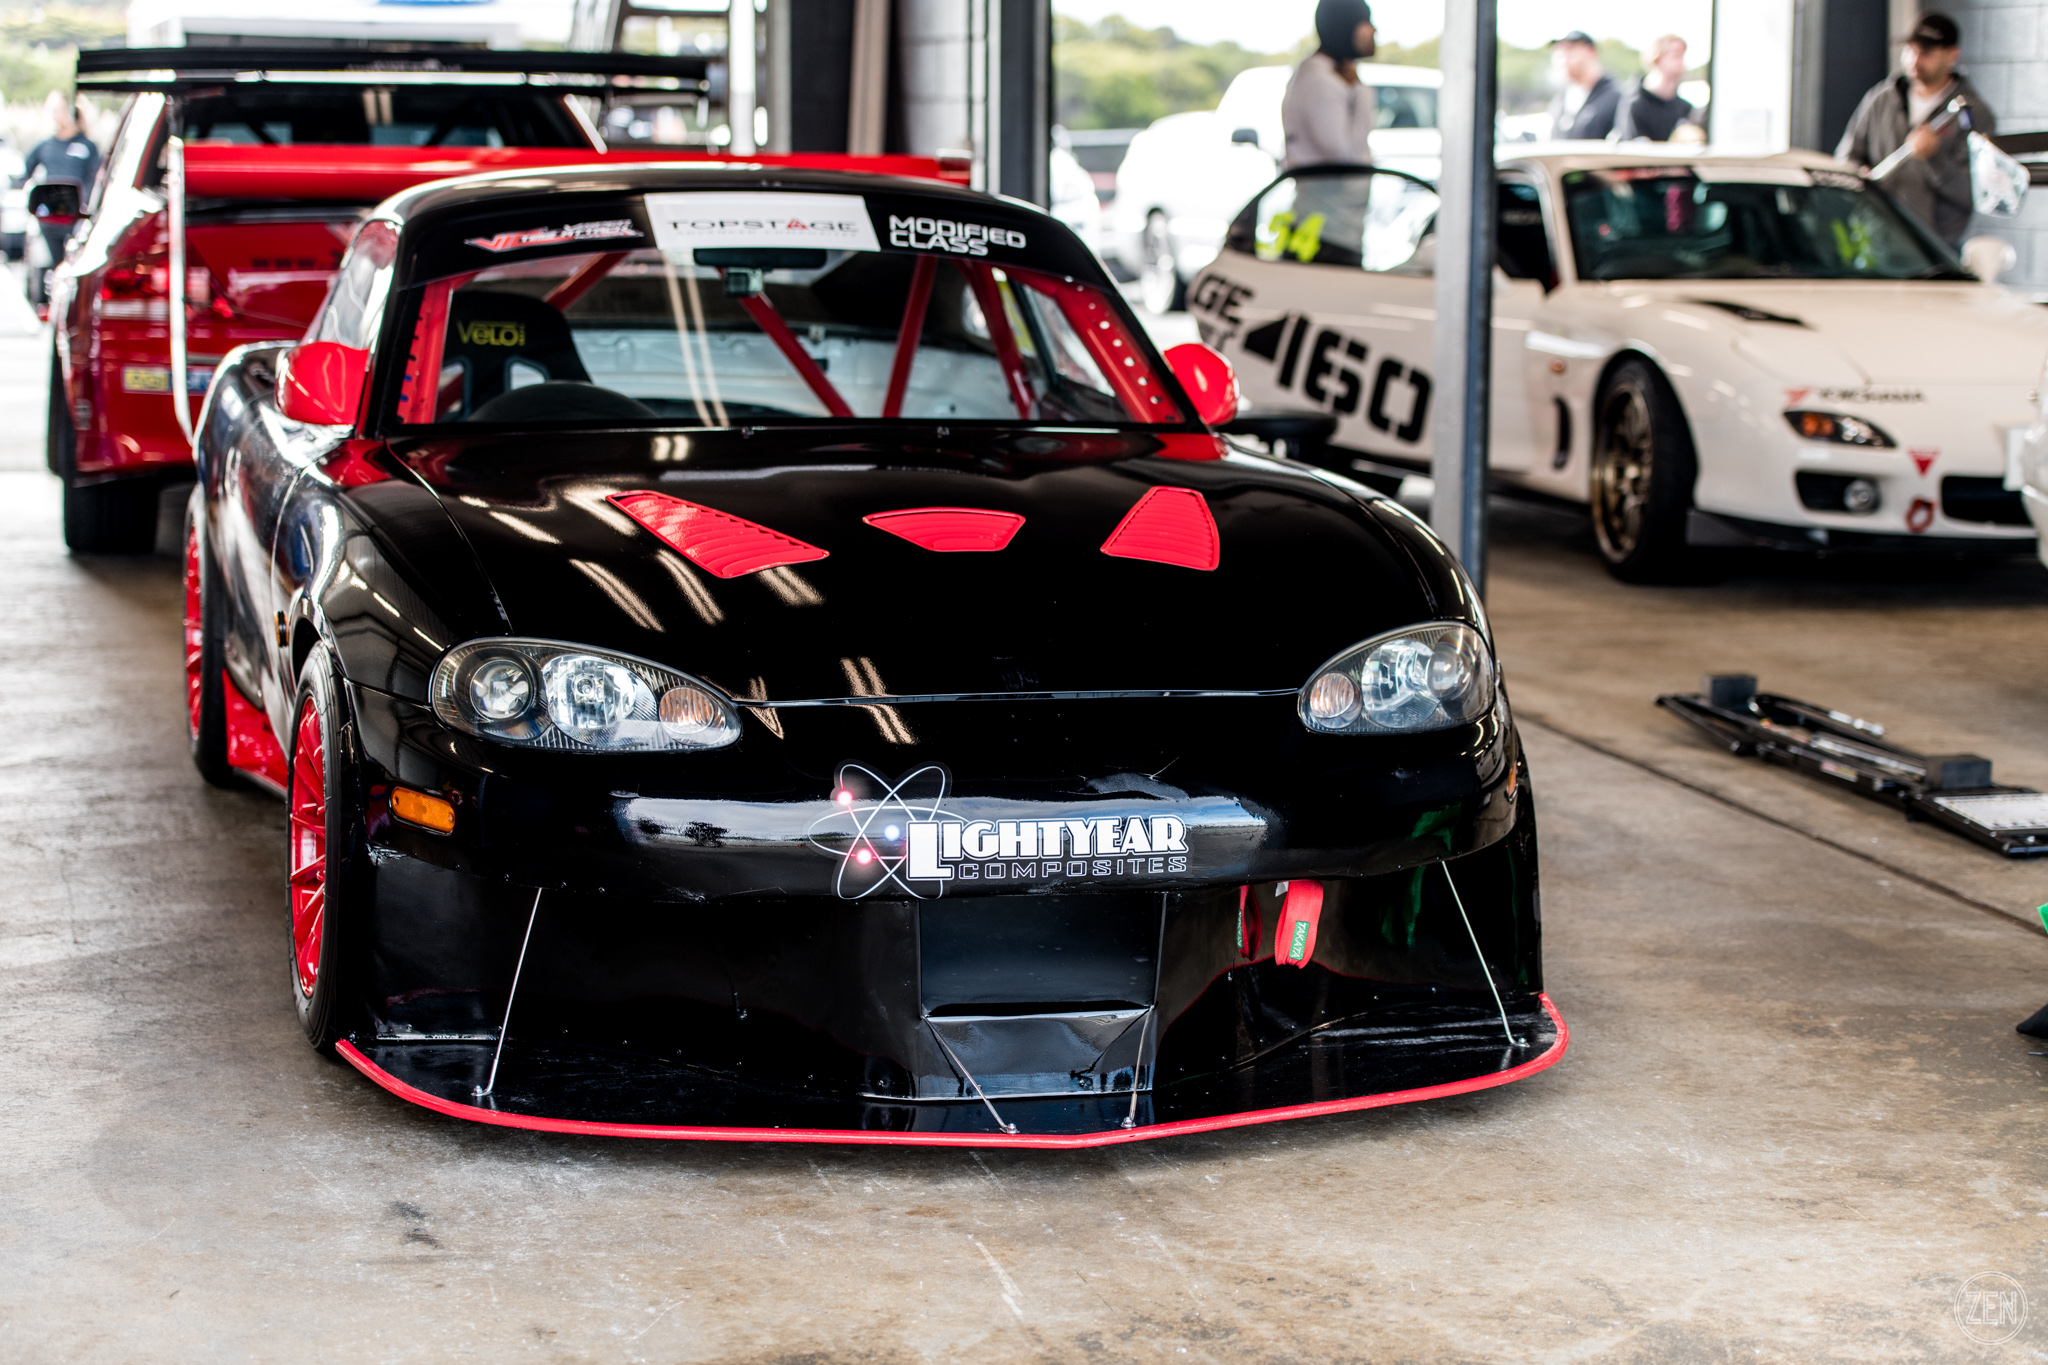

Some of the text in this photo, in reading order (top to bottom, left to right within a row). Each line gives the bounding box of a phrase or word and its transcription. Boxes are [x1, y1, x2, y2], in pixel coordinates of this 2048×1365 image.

[667, 217, 860, 232] TOPSTAGE
[889, 214, 1026, 249] MODIFIED
[890, 229, 988, 256] CLASS
[906, 814, 1189, 880] LIGHTYEAR
[958, 856, 1187, 880] COMPOSITES
[1290, 921, 1307, 958] TAKATA
